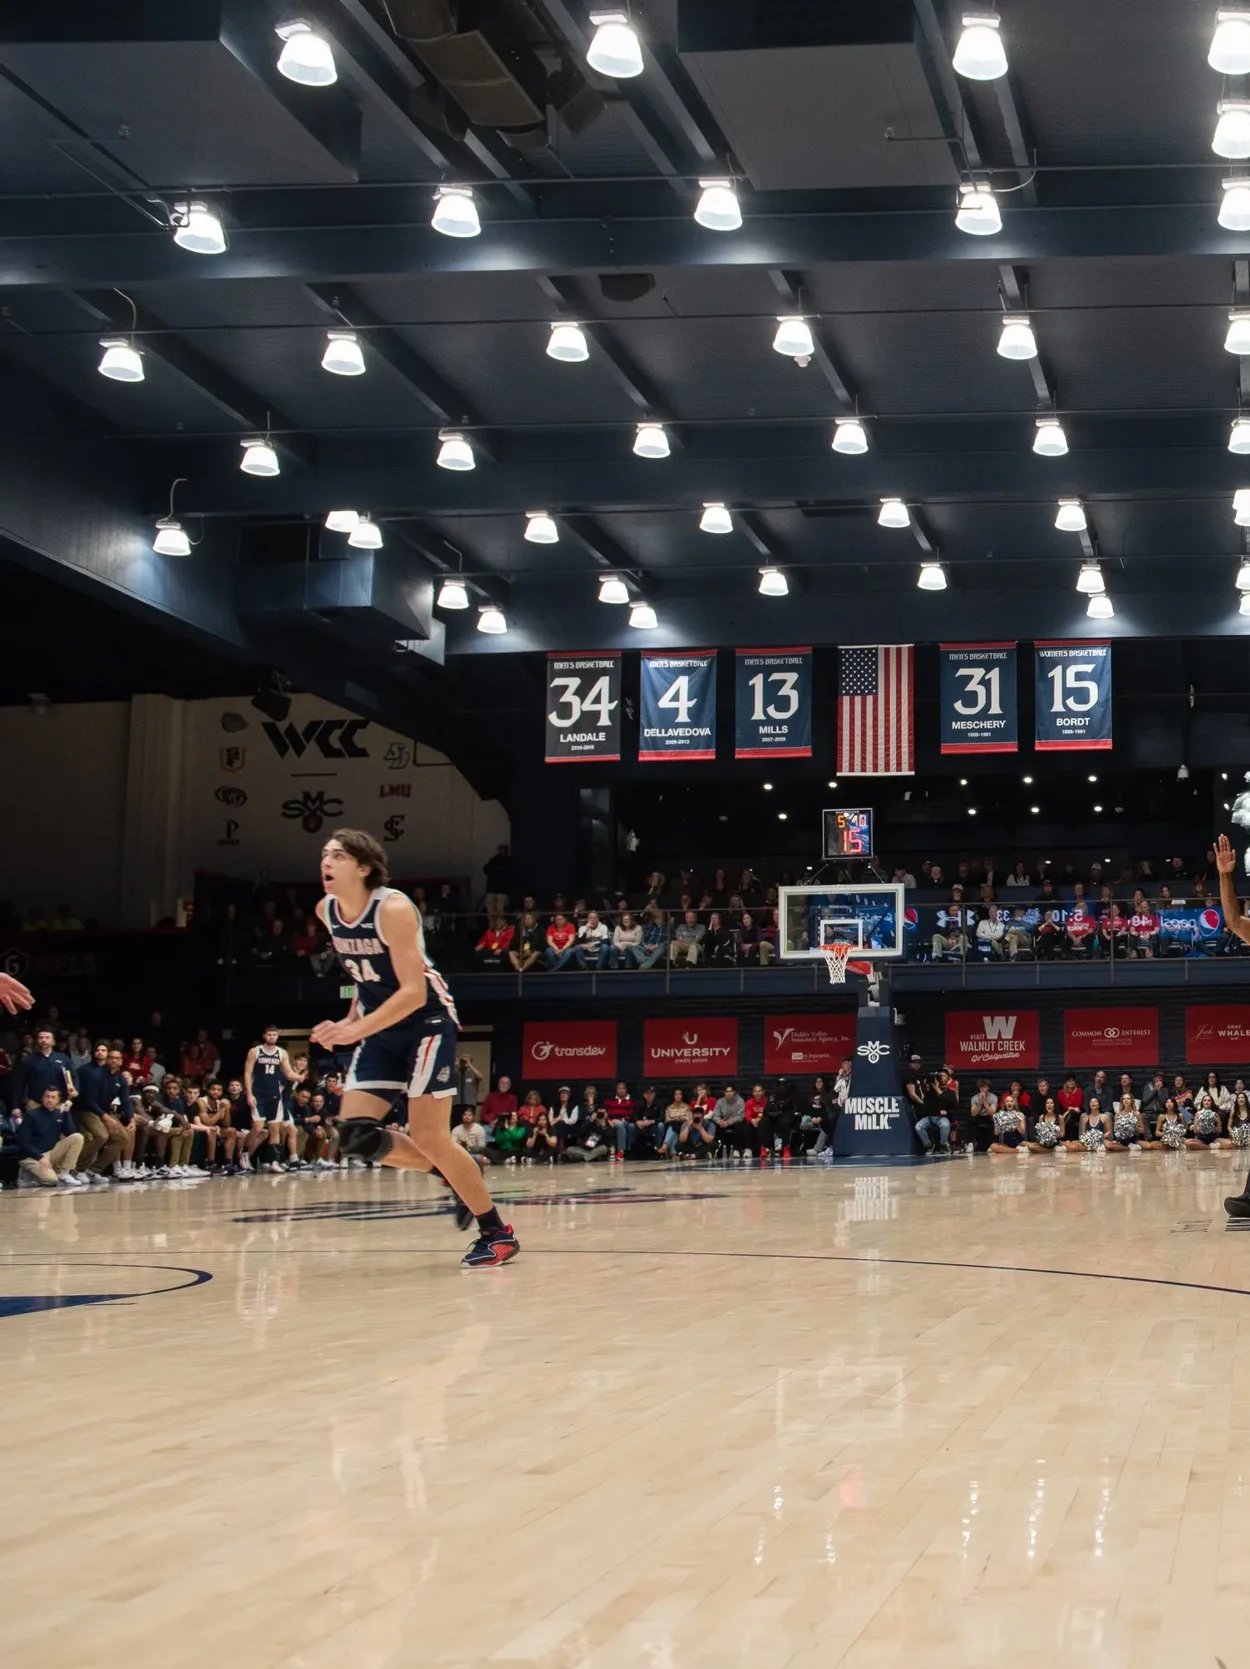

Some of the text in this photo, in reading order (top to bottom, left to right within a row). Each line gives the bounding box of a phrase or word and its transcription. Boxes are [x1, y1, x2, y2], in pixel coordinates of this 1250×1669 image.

[953, 667, 1003, 715] 31
[1048, 664, 1098, 712] 15
[548, 676, 618, 727] 34
[658, 676, 698, 723] 4
[749, 672, 799, 720] 13
[952, 720, 1006, 730] MESCHERY
[1056, 717, 1091, 726] BORDT
[644, 727, 711, 738] DELLAVEDOVA
[759, 725, 788, 734] MILLS
[261, 719, 370, 759] WCC
[560, 732, 606, 743] LANDALE
[379, 784, 411, 798] LMU
[843, 829, 862, 852] 15
[983, 1016, 1017, 1039] W
[554, 1046, 606, 1057] transdev
[651, 1047, 730, 1058] UNIVERSITY
[960, 1040, 1025, 1052] WALNUT CREEK
[265, 1064, 275, 1075] 14
[845, 1097, 900, 1114] MUSCLE
